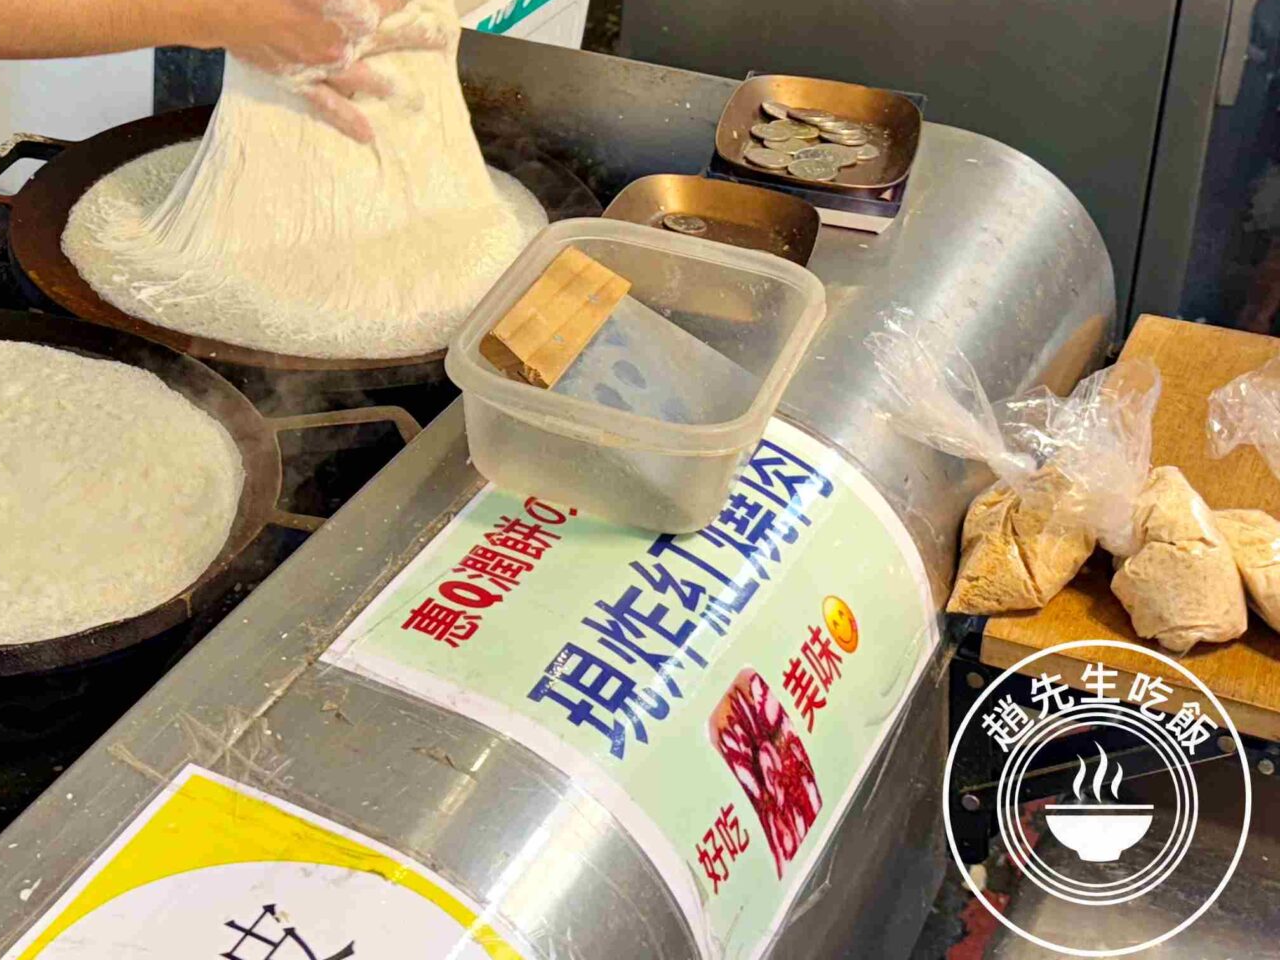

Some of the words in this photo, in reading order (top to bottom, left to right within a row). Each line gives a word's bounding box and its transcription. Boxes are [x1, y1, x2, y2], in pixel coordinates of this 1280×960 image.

[527, 438, 834, 760] 現炸紅燒肉
[782, 625, 842, 733] 美味
[695, 803, 750, 895] 好吃
